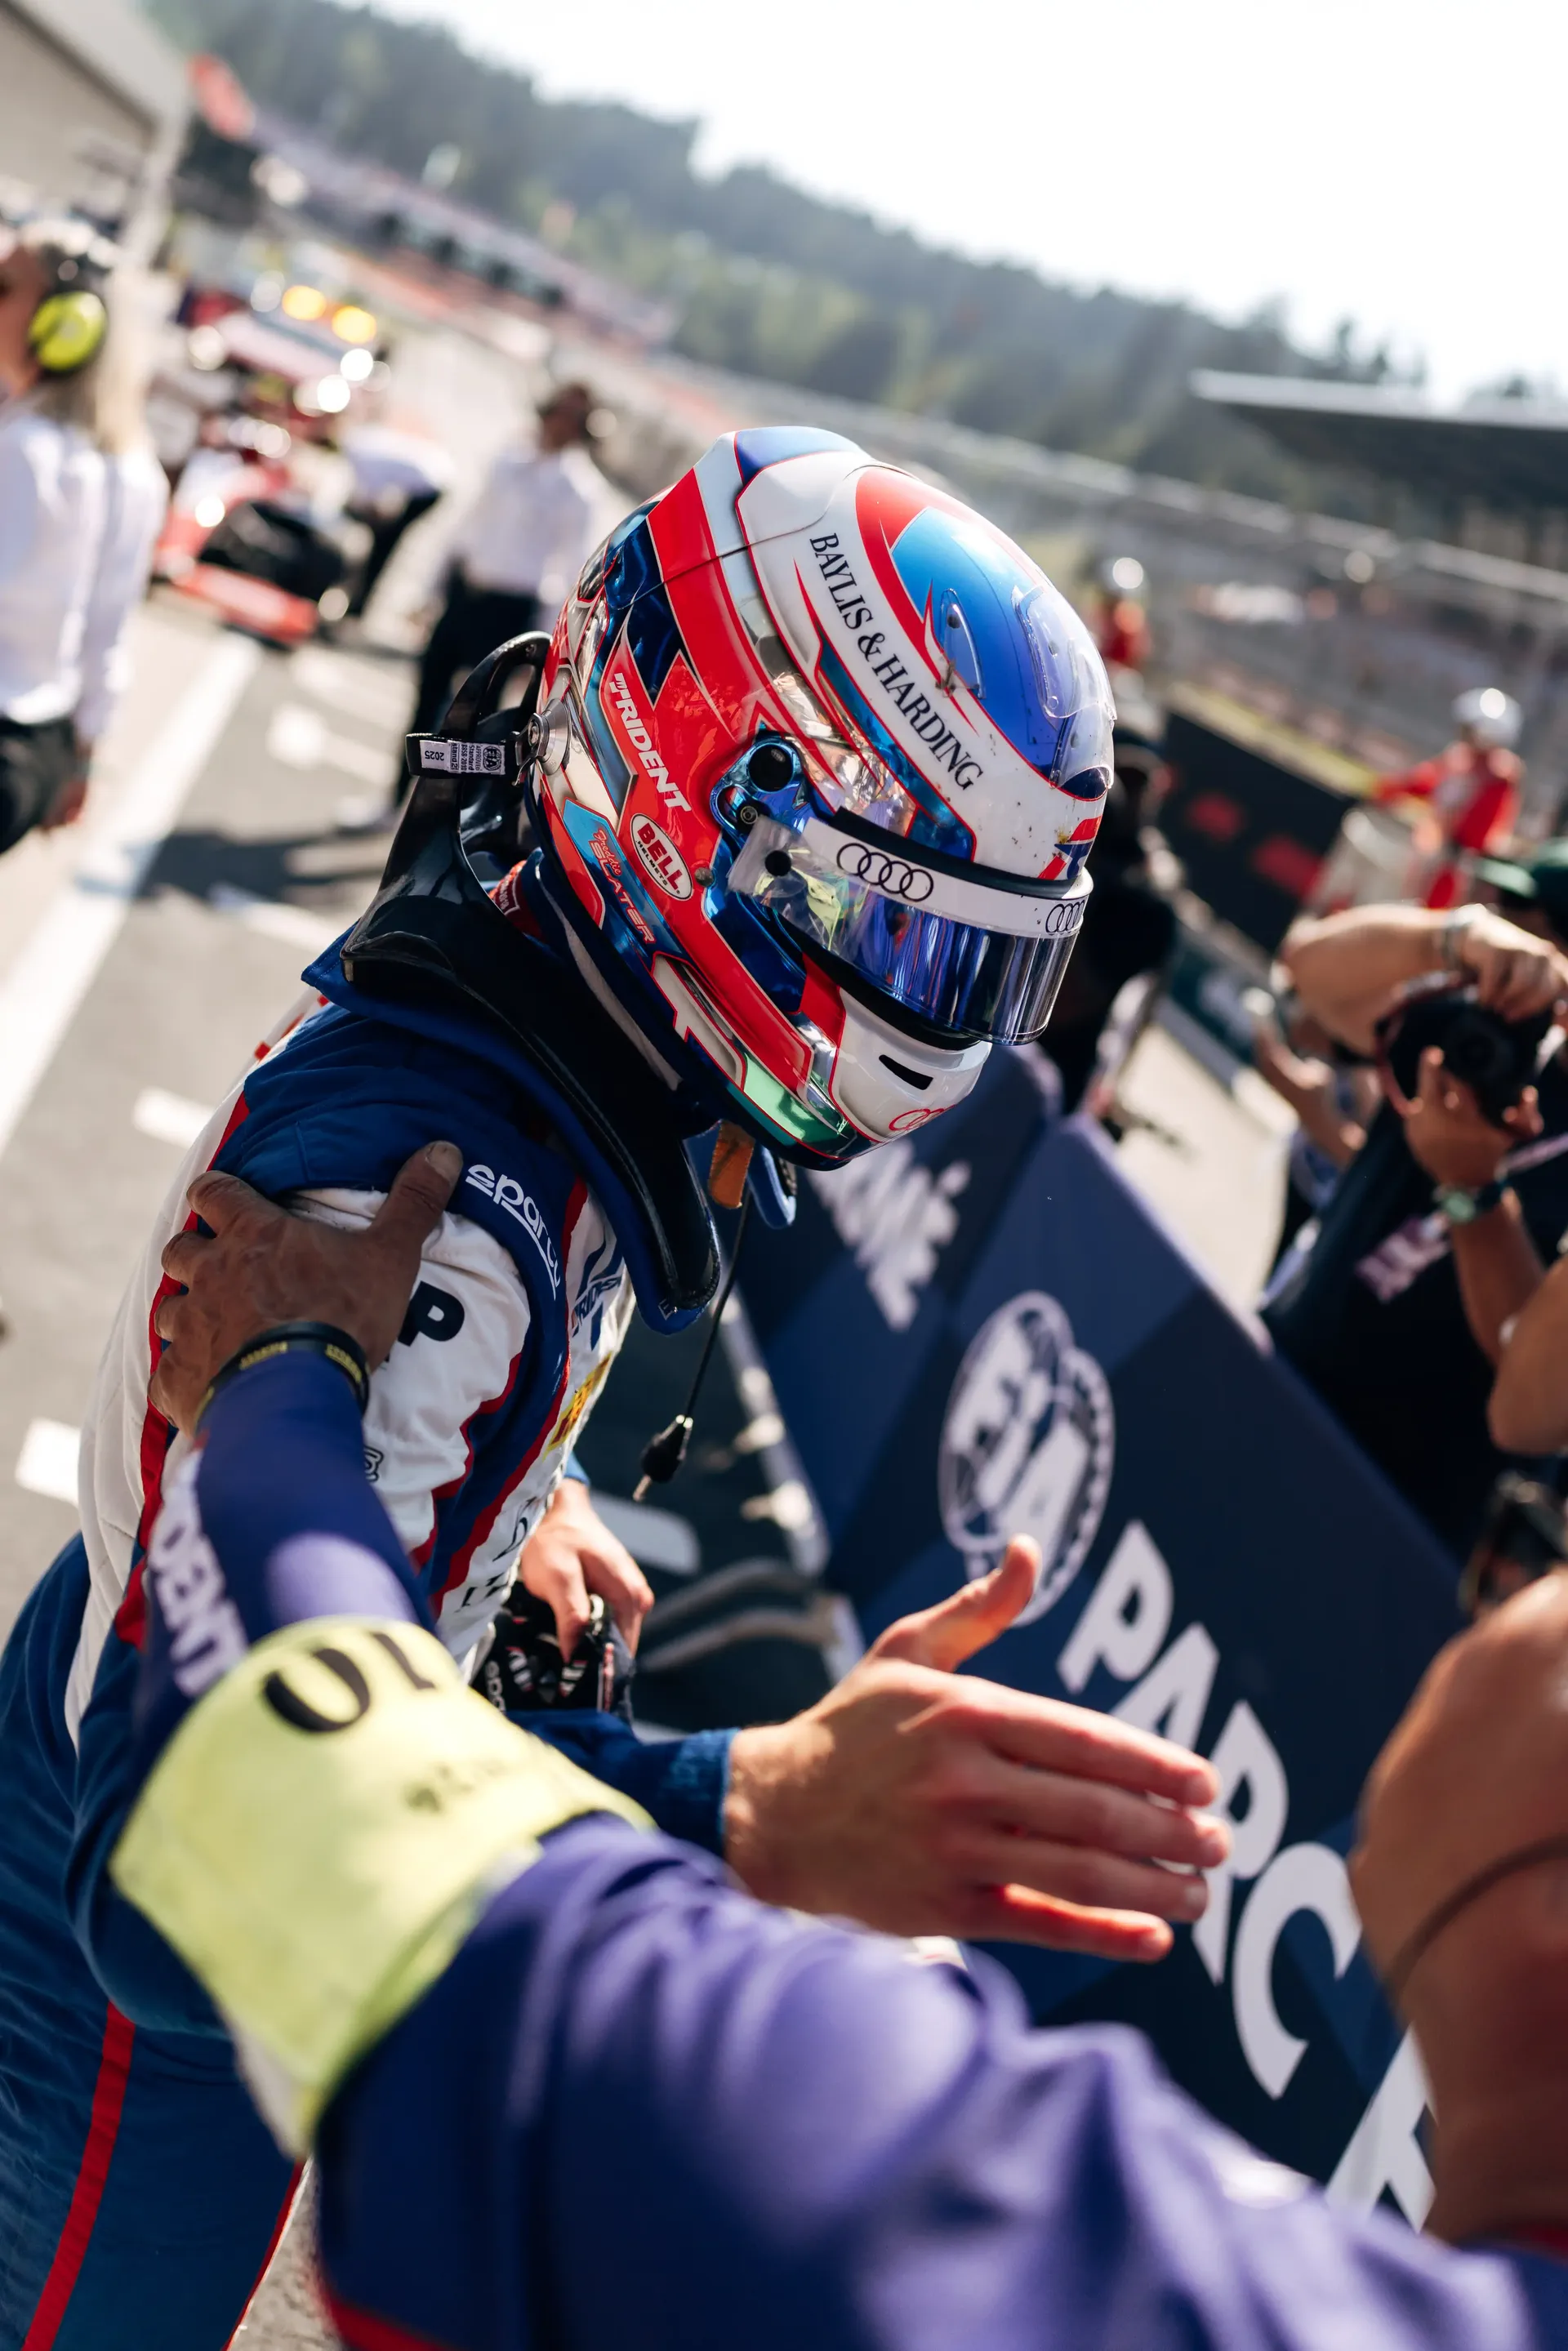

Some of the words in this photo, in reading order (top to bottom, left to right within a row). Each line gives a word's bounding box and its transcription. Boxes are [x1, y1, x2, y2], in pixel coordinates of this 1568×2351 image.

[809, 532, 873, 630] BAYLIS
[858, 632, 885, 661] &
[872, 654, 983, 790] HARDING
[425, 750, 444, 761] 2025
[609, 672, 692, 812] TRIDENT
[593, 828, 621, 875] Freddie
[637, 822, 682, 891] BELL
[637, 840, 668, 886] HELMETS
[589, 841, 655, 942] SLATER
